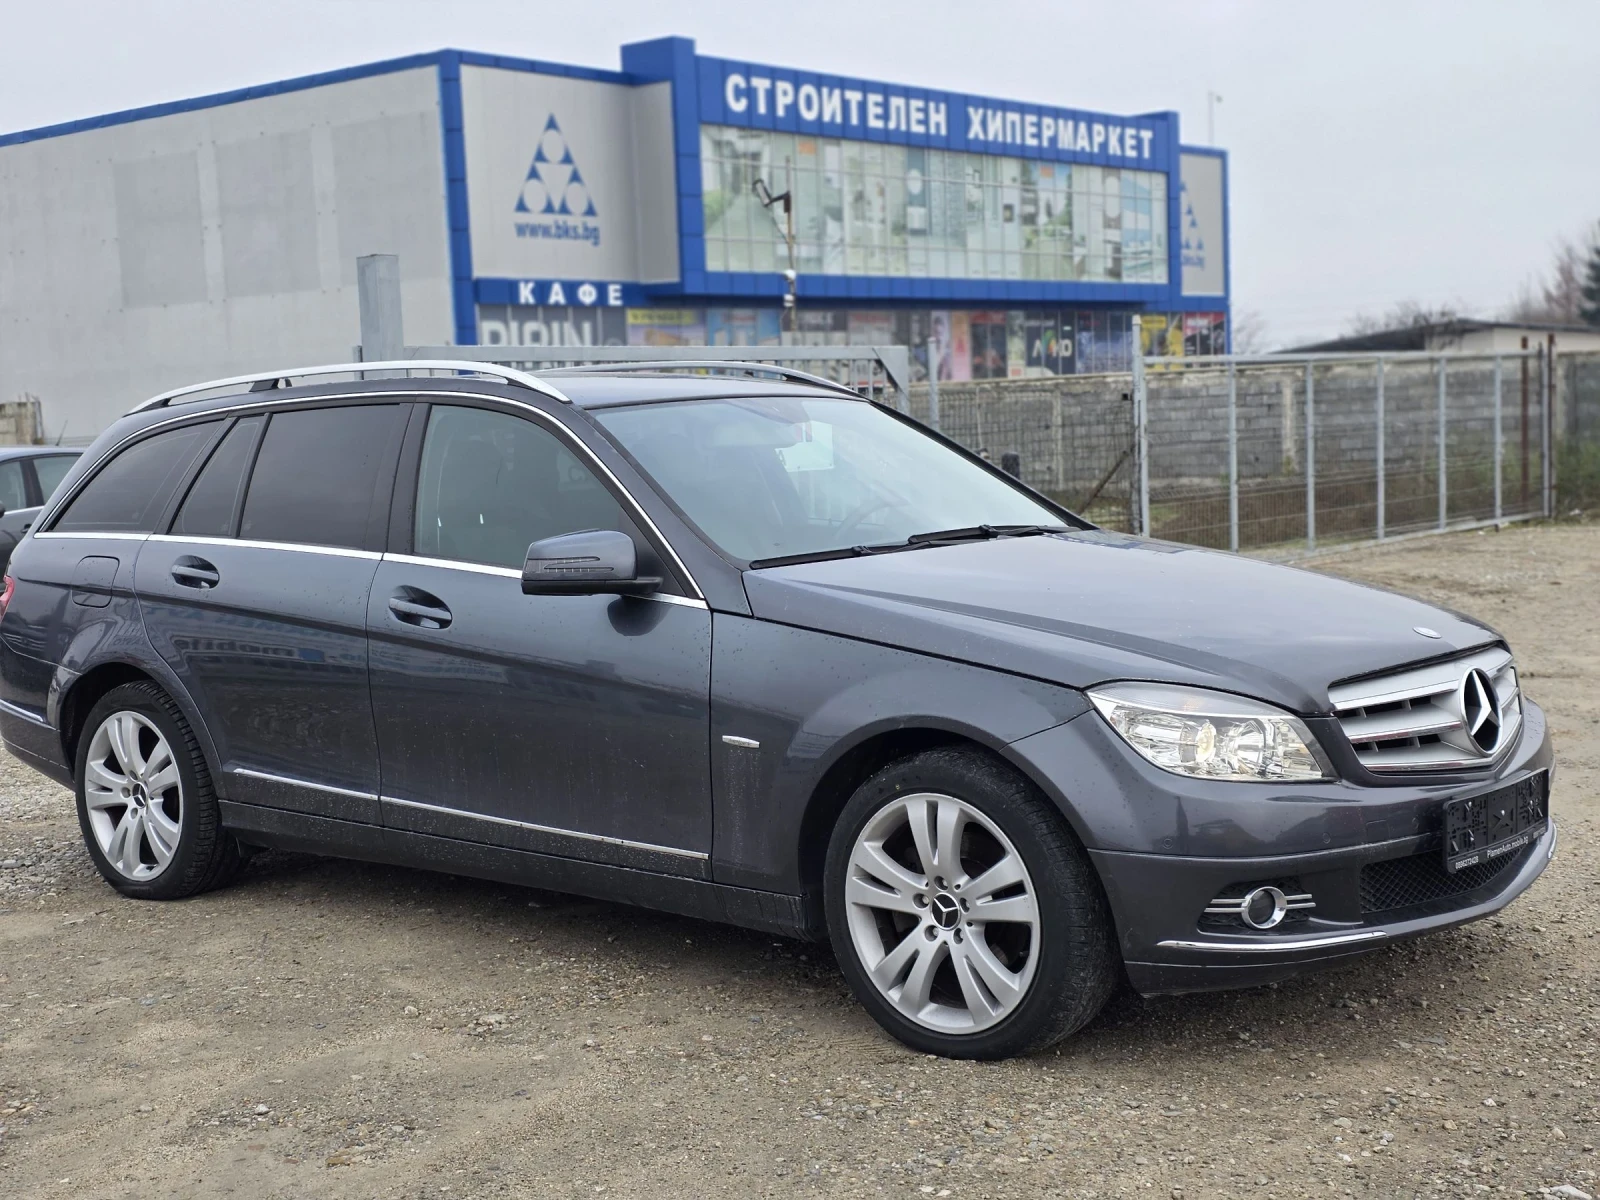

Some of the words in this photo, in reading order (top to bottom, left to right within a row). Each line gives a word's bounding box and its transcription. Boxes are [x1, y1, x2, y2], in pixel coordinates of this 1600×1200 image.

[725, 73, 948, 137] СТРОИТЕЛЕН
[967, 106, 1154, 160] ХИПЕРМАРКЕТ
[514, 219, 601, 247] www.bks.bg
[518, 281, 624, 307] КАФЕ
